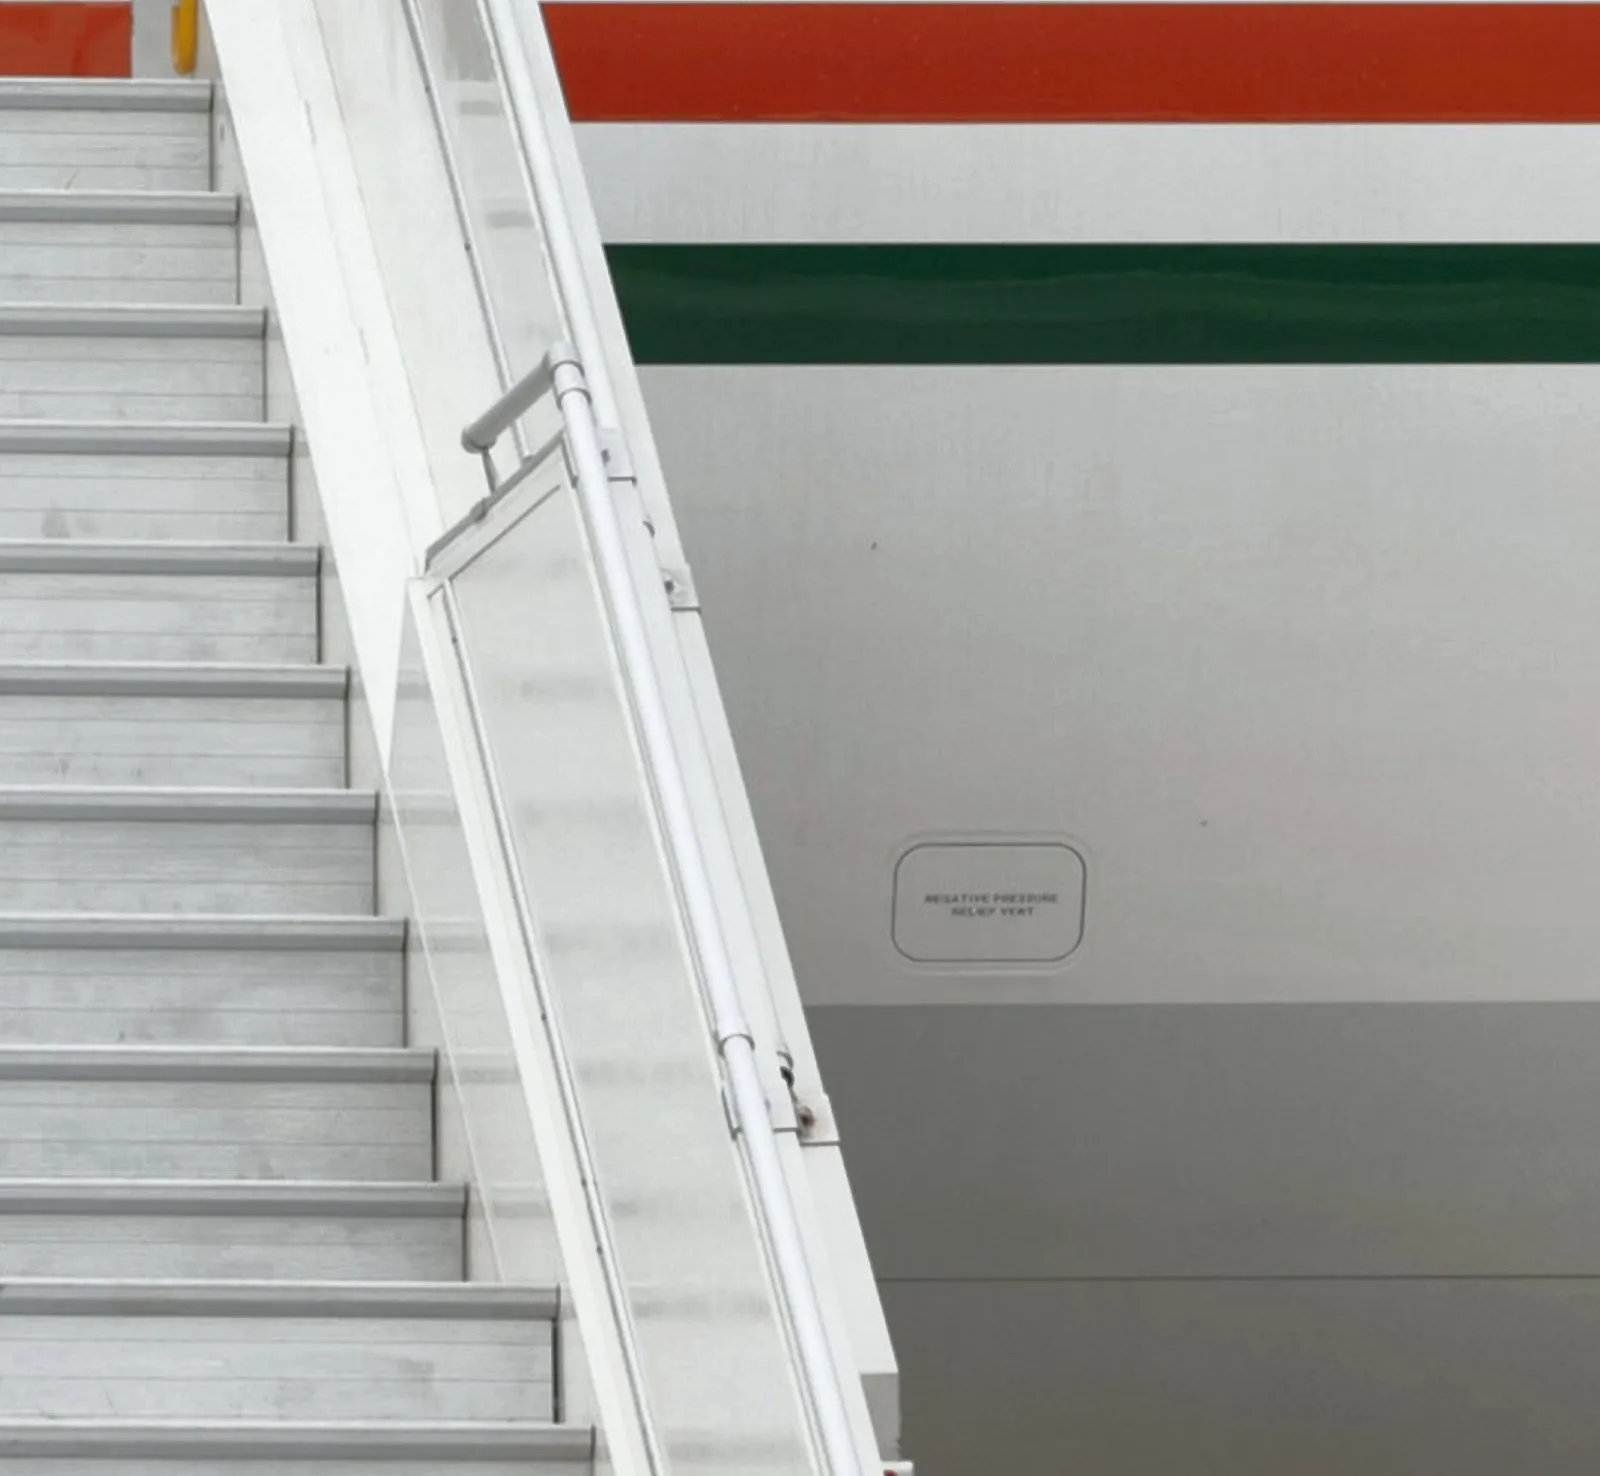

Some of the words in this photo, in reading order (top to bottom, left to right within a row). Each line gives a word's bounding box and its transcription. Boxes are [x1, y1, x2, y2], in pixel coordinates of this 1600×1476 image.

[923, 893, 990, 904] NEGATIVE
[993, 893, 1058, 904] PRESSURE
[951, 907, 997, 917] RELIEF
